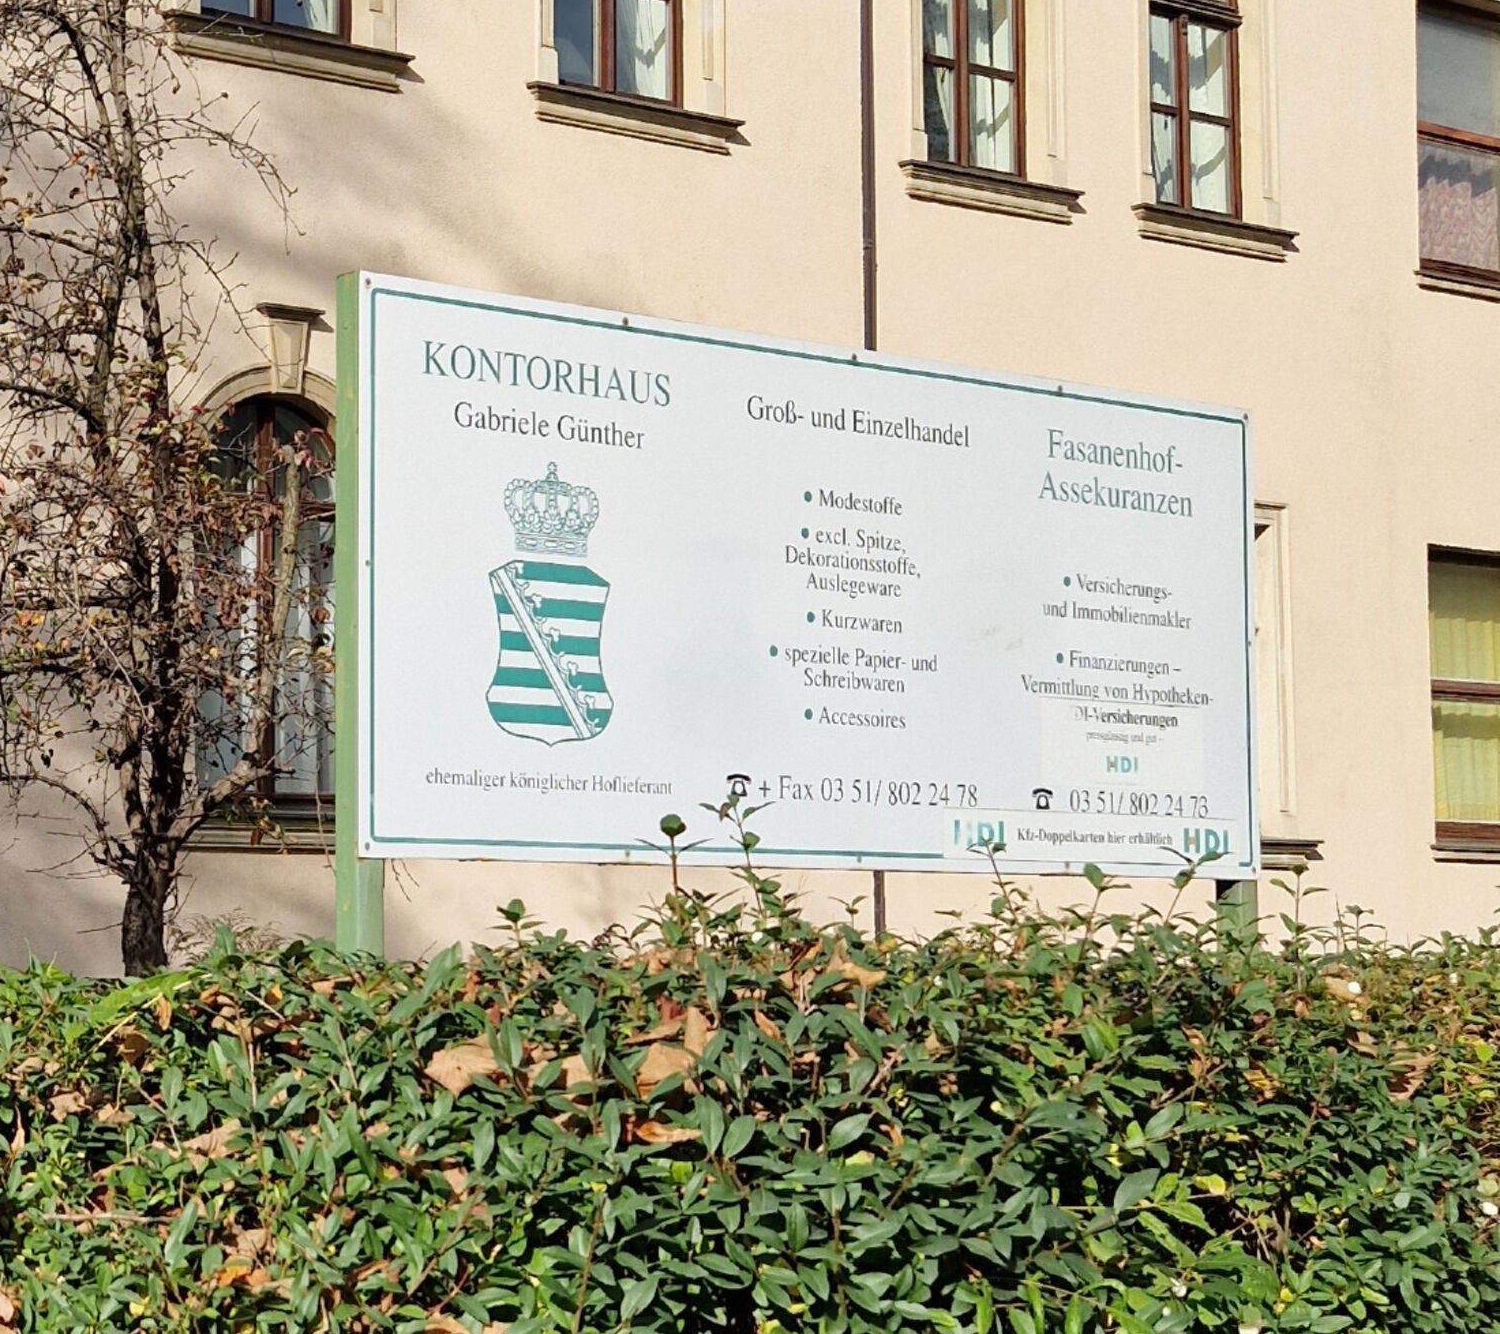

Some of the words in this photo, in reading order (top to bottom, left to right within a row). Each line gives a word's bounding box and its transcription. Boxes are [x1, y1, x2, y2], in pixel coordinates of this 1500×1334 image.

[422, 340, 671, 407] KONTORHAUS
[454, 401, 550, 438] Gabriele
[557, 414, 645, 449] Günther
[747, 395, 804, 425] Groß-
[811, 408, 846, 431] und
[852, 409, 971, 448] Einzelhandel
[1047, 428, 1183, 474] Fasanenhof-
[819, 489, 902, 515] Modestoffe
[1038, 471, 1193, 517] Assekuranzen
[816, 528, 850, 547] excl.
[856, 529, 906, 554] Spitze,
[785, 545, 921, 579] Dekorationsstoffe,
[806, 572, 901, 599] Auslegeware
[1076, 573, 1172, 604] Versicherungs-
[822, 609, 902, 633] Kurzwaren
[1043, 601, 1067, 618] und
[1072, 601, 1192, 629] Immobilienmakler
[785, 644, 850, 667] spezielle
[855, 648, 906, 673] Papier-
[912, 654, 937, 672] und
[1069, 650, 1169, 679] Finanzierungen
[804, 668, 905, 693] Schreibwaren
[1021, 674, 1100, 700] Vermittlung
[1105, 685, 1128, 700] von
[1133, 683, 1214, 707] Hypotheken-
[819, 706, 906, 729] Accessoires
[1106, 755, 1139, 774] HDI
[426, 768, 506, 791] ehemaliger
[510, 771, 588, 794] königlicher
[592, 775, 673, 795] Hoflieferant
[758, 779, 771, 798] +
[779, 776, 813, 801] Fax
[821, 777, 844, 802] 03
[851, 779, 882, 806] 51/
[888, 781, 921, 806] 802
[928, 782, 950, 806] 24
[957, 784, 978, 807] 78
[1070, 789, 1090, 813] 03
[1096, 790, 1124, 815] 51/
[1129, 791, 1158, 816] 802
[1164, 794, 1183, 818] 24
[1016, 827, 1104, 845] Kfz-Doppelkarten
[1107, 829, 1125, 843] hier
[1128, 831, 1173, 846] erhältlich
[1183, 827, 1229, 854] HDI
